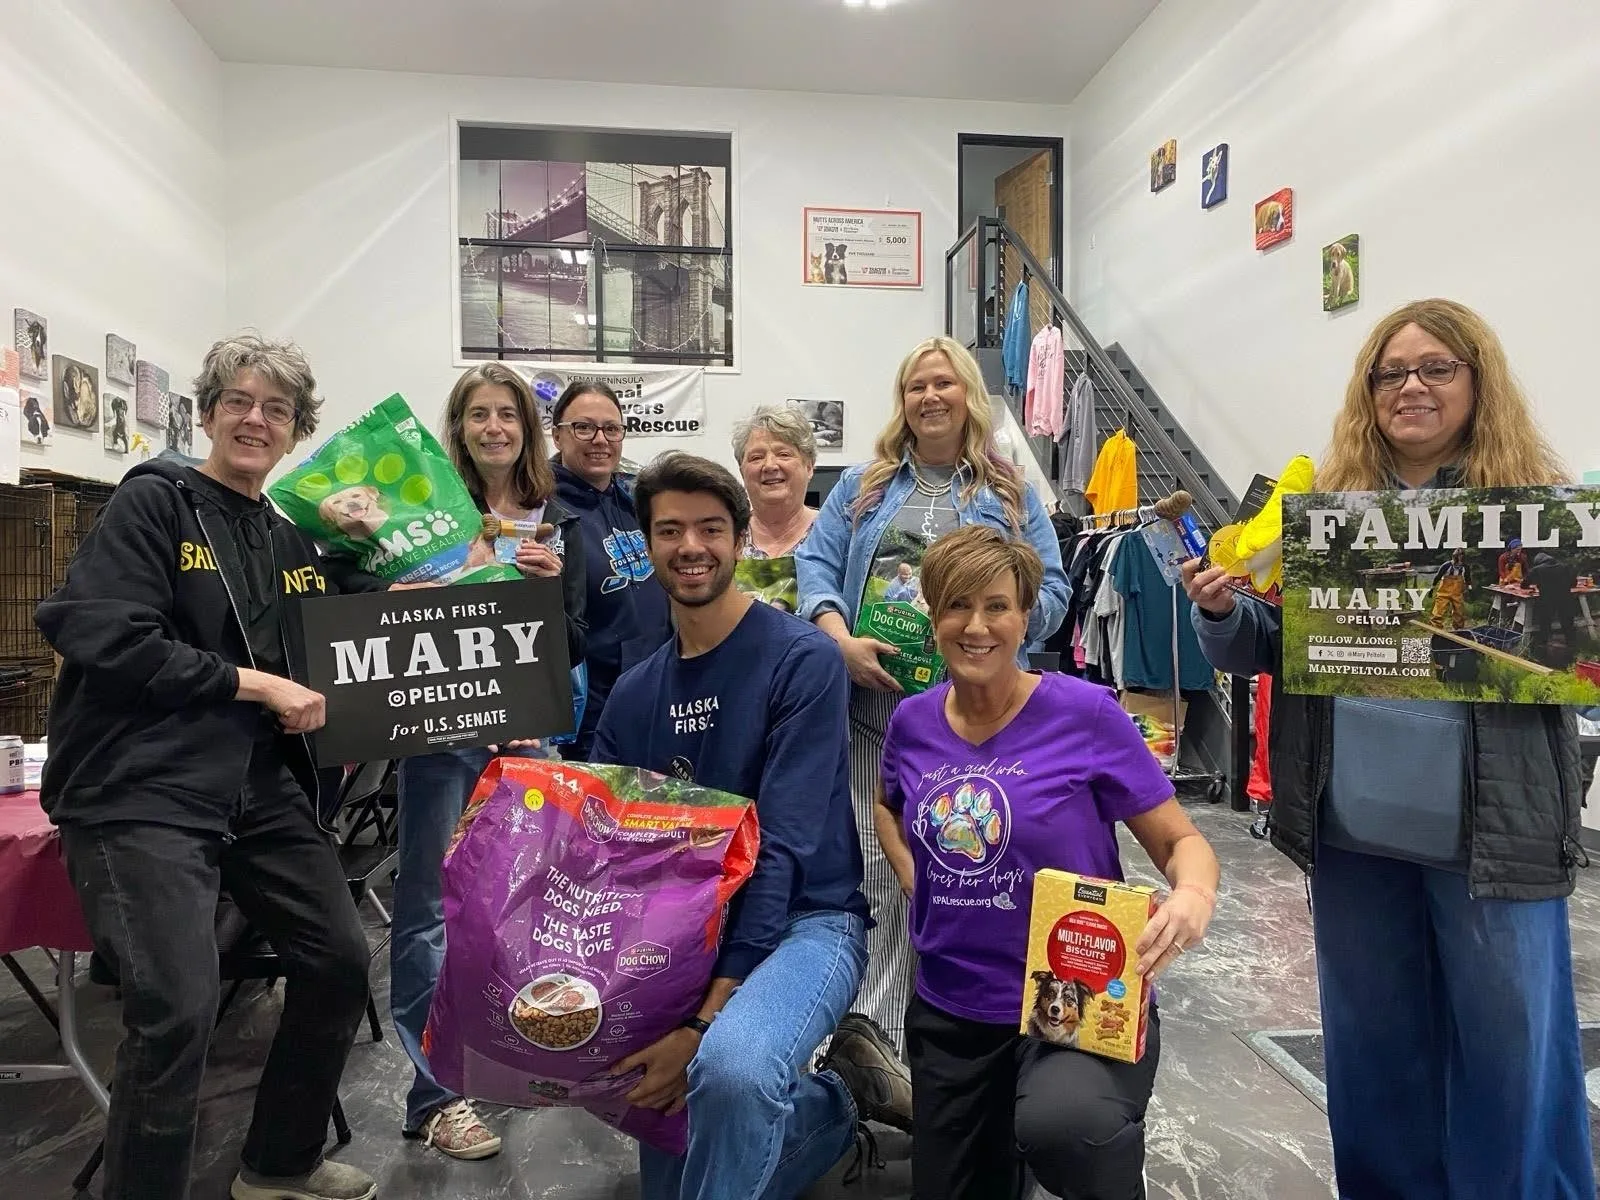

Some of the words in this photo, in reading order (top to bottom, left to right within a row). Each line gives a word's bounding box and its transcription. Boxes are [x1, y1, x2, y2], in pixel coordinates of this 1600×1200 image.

[626, 417, 700, 434] Rescue
[1305, 502, 1600, 550] FAMILY
[423, 531, 464, 556] HEALTH
[1308, 587, 1432, 611] MARY
[380, 607, 445, 626] ALASKA
[452, 602, 502, 618] FIRST.
[873, 610, 894, 626] DOG
[896, 618, 926, 634] CHOW
[893, 608, 916, 618] PURINA
[1347, 615, 1401, 626] PELTOLA
[330, 620, 544, 685] MARY
[1308, 635, 1353, 644] FOLLOW
[1355, 636, 1397, 646] ALONG:
[1308, 663, 1431, 677] MARYPELTOLA.COM
[409, 678, 501, 705] PELTOLA
[669, 696, 719, 718] ALASKA
[389, 723, 420, 741] for
[424, 717, 453, 734] U.S.
[457, 709, 507, 729] SENATE
[675, 714, 714, 734] FIRS.
[917, 763, 950, 791] just
[952, 767, 961, 775] a
[963, 758, 998, 783] girl
[996, 761, 1029, 776] who
[623, 819, 660, 829] SMART
[546, 866, 569, 889] THE
[566, 883, 644, 905] NUTRITION
[927, 861, 956, 886] loves
[959, 868, 984, 889] her
[989, 867, 1025, 892] dogs
[543, 888, 580, 917] DOGS
[582, 902, 624, 919] NEED.
[932, 895, 991, 908] KPALrescue.org
[543, 914, 568, 937] THE
[572, 922, 612, 941] TASTE
[533, 928, 572, 954] DOGS
[576, 938, 615, 958] LOVE.
[1057, 929, 1116, 953] MULTI-FLAVOR
[1065, 945, 1106, 960] BISCUITS
[620, 955, 638, 967] DOG
[640, 954, 668, 966] CHOW
